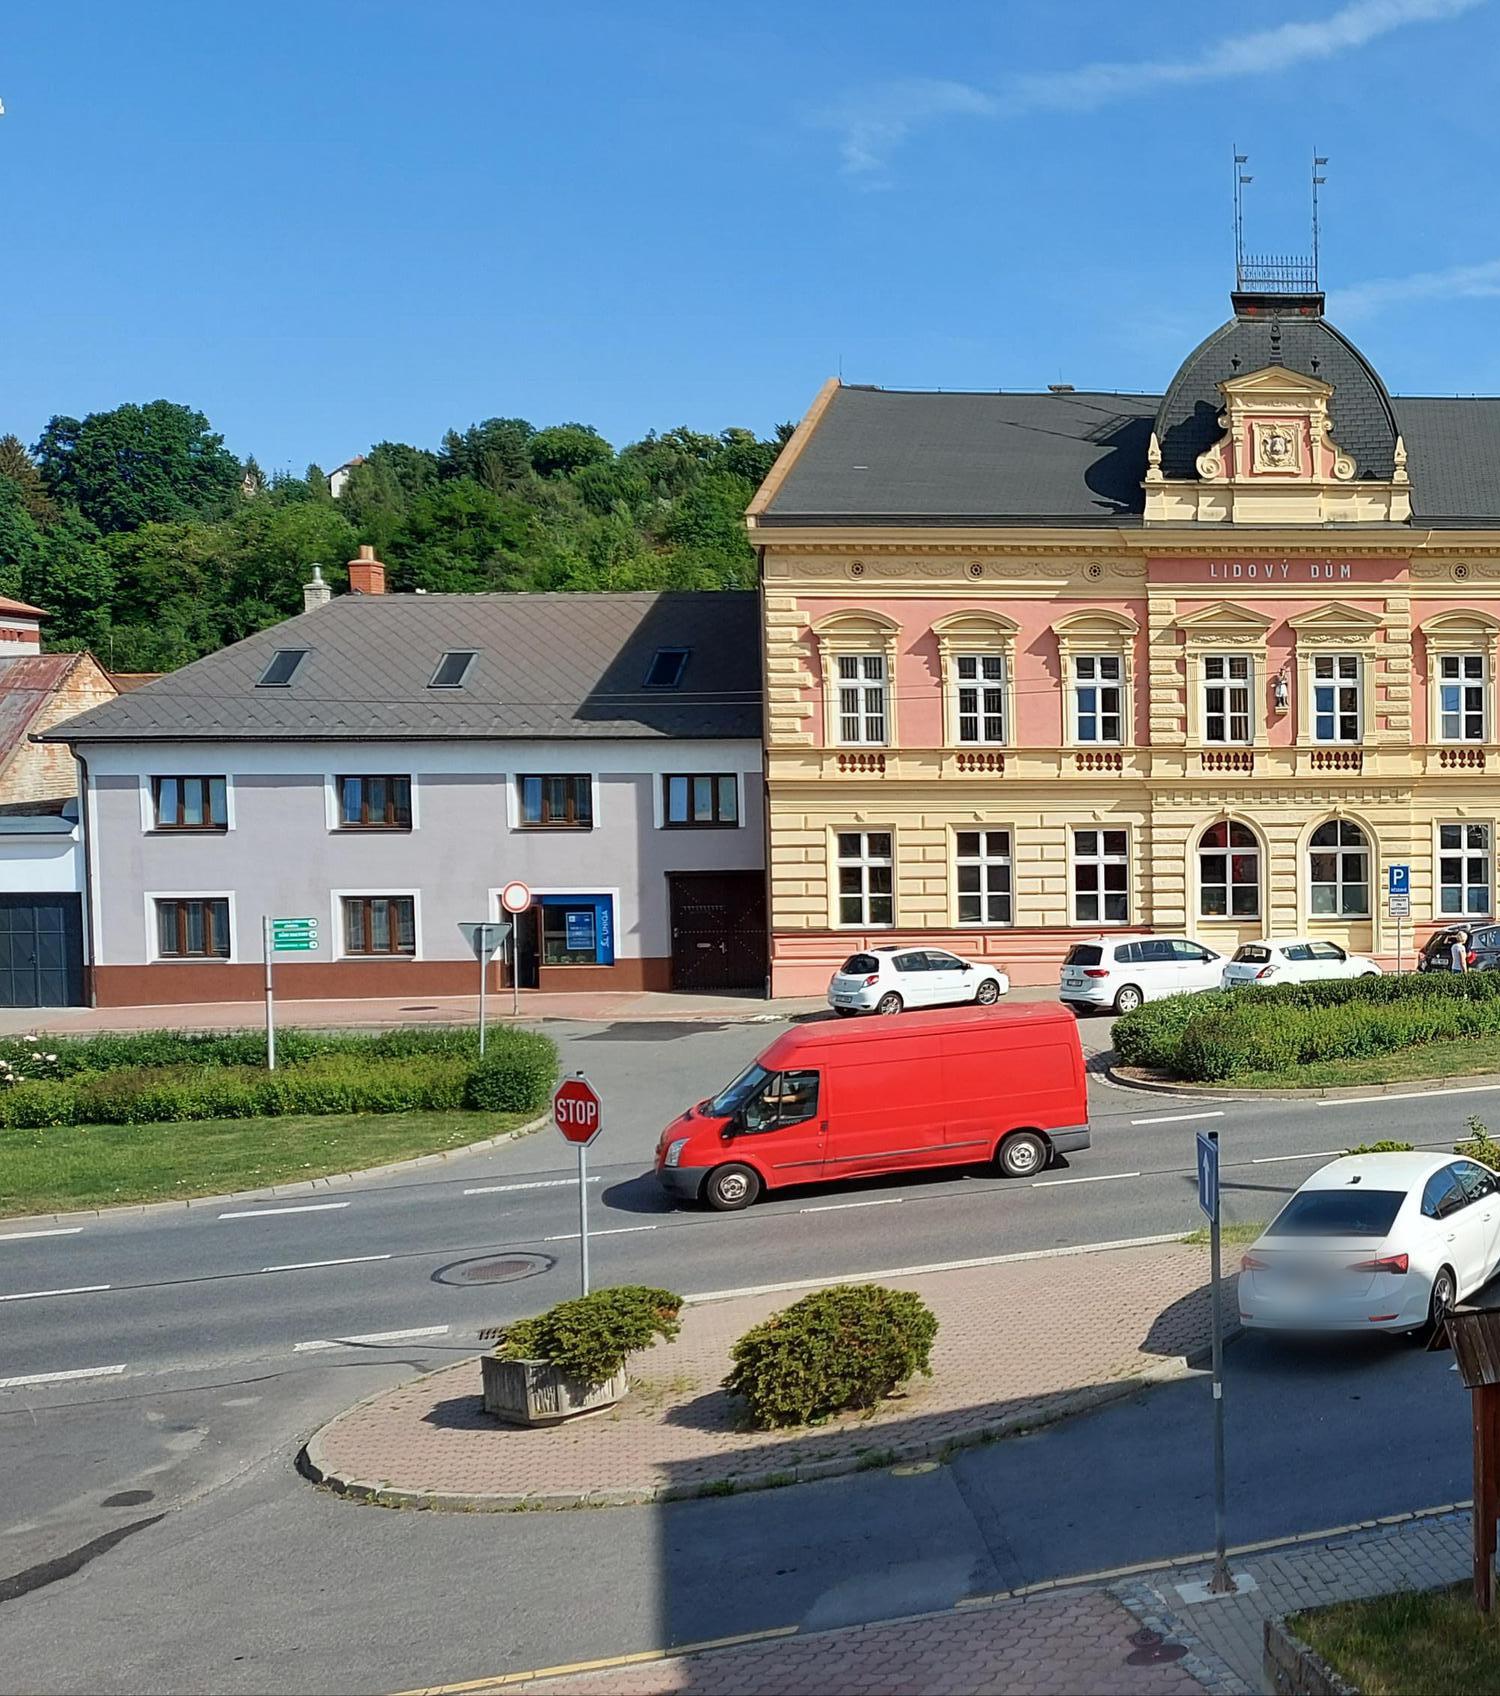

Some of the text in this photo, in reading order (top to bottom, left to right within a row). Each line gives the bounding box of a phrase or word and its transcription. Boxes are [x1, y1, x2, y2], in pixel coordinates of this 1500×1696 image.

[1210, 559, 1351, 578] LIDOVÝ DŮM
[1393, 868, 1404, 885] P
[557, 1098, 597, 1125] STOP
